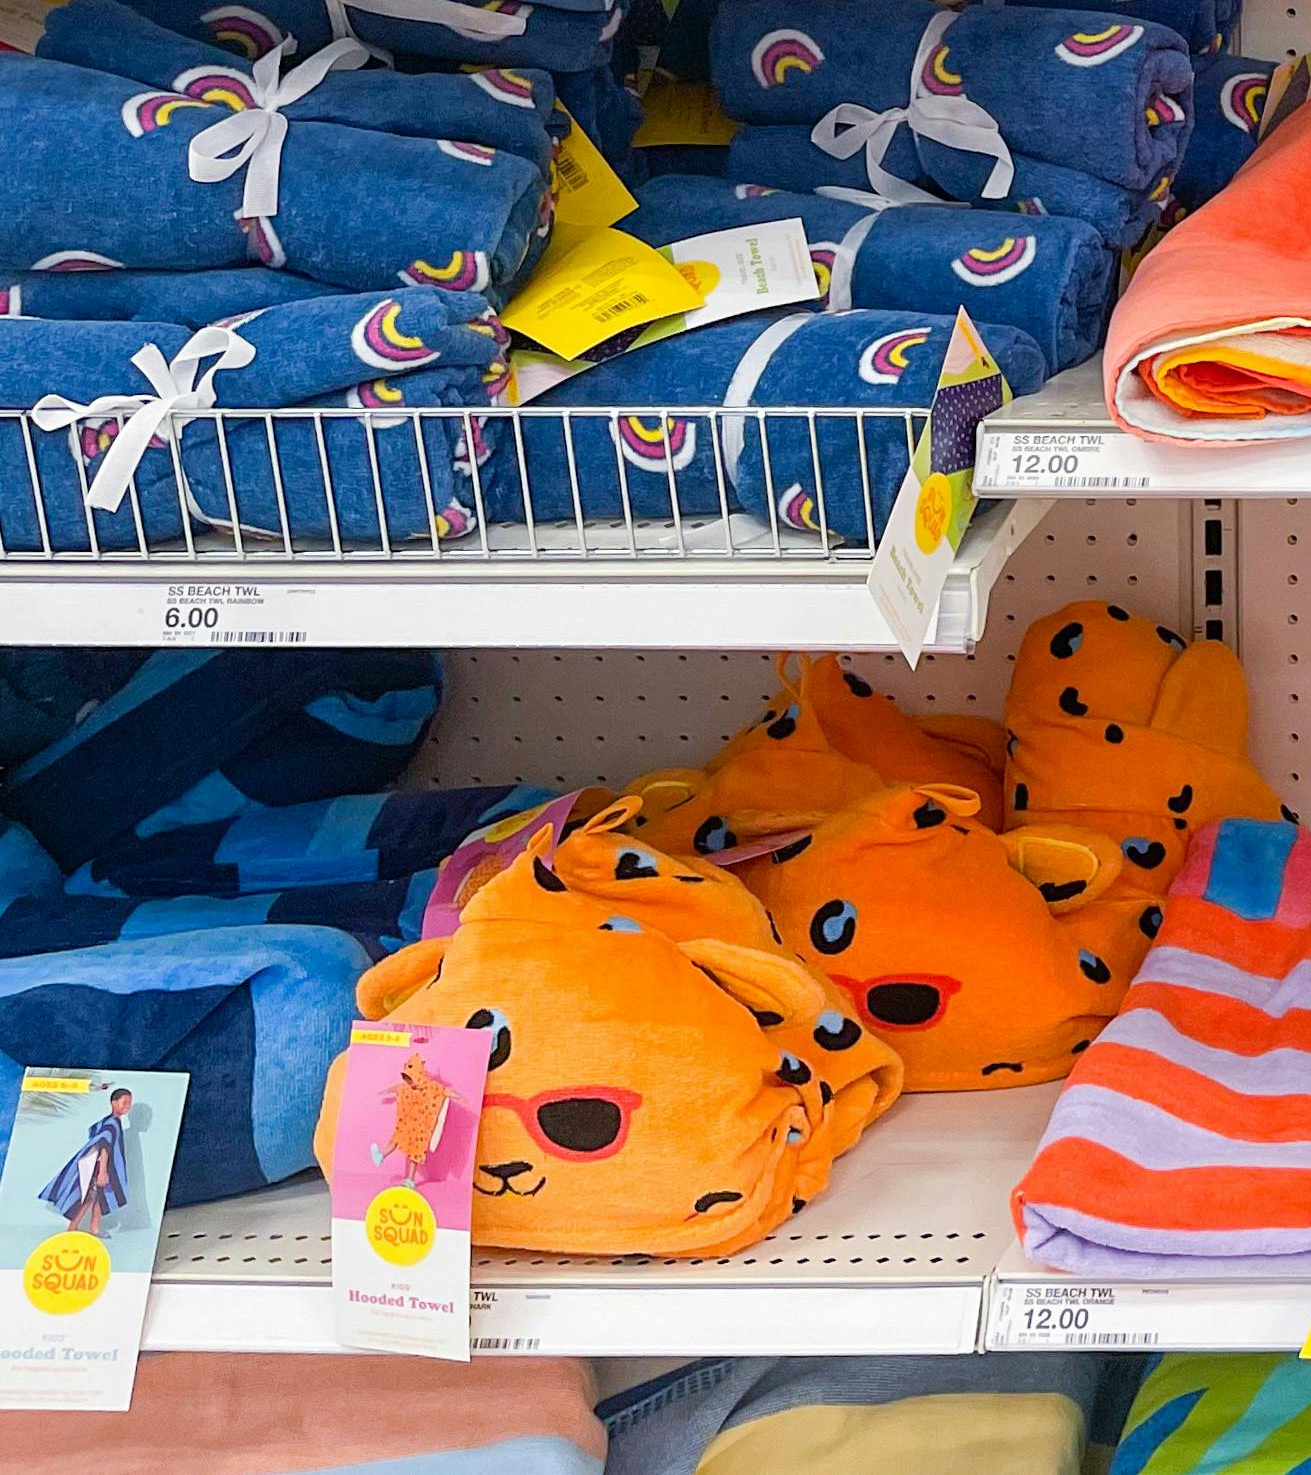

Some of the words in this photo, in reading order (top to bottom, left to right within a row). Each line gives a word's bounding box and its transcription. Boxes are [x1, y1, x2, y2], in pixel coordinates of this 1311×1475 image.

[745, 237, 763, 266] Towel
[753, 268, 769, 295] Beach
[1013, 435, 1030, 445] SS
[1033, 435, 1076, 445] BEACH
[1080, 435, 1105, 445] TWL
[1012, 454, 1079, 474] 12.00
[168, 586, 184, 596] SS
[188, 586, 231, 596] BEACH
[235, 586, 262, 596] TWL
[165, 607, 219, 628] 6.00
[379, 1205, 424, 1227] SUN
[374, 1225, 429, 1247] SQUAD
[42, 1252, 97, 1272] SUN
[32, 1272, 99, 1295] SQUAD
[1025, 1288, 1041, 1298] SS
[1045, 1288, 1087, 1298] BEACH
[1091, 1288, 1115, 1298] TWL
[348, 1289, 404, 1308] Hooded
[409, 1296, 455, 1314] Towel
[474, 1291, 498, 1302] TWL
[1024, 1308, 1089, 1329] 12.00
[0, 1347, 56, 1361] ooded
[62, 1347, 120, 1362] Towel
